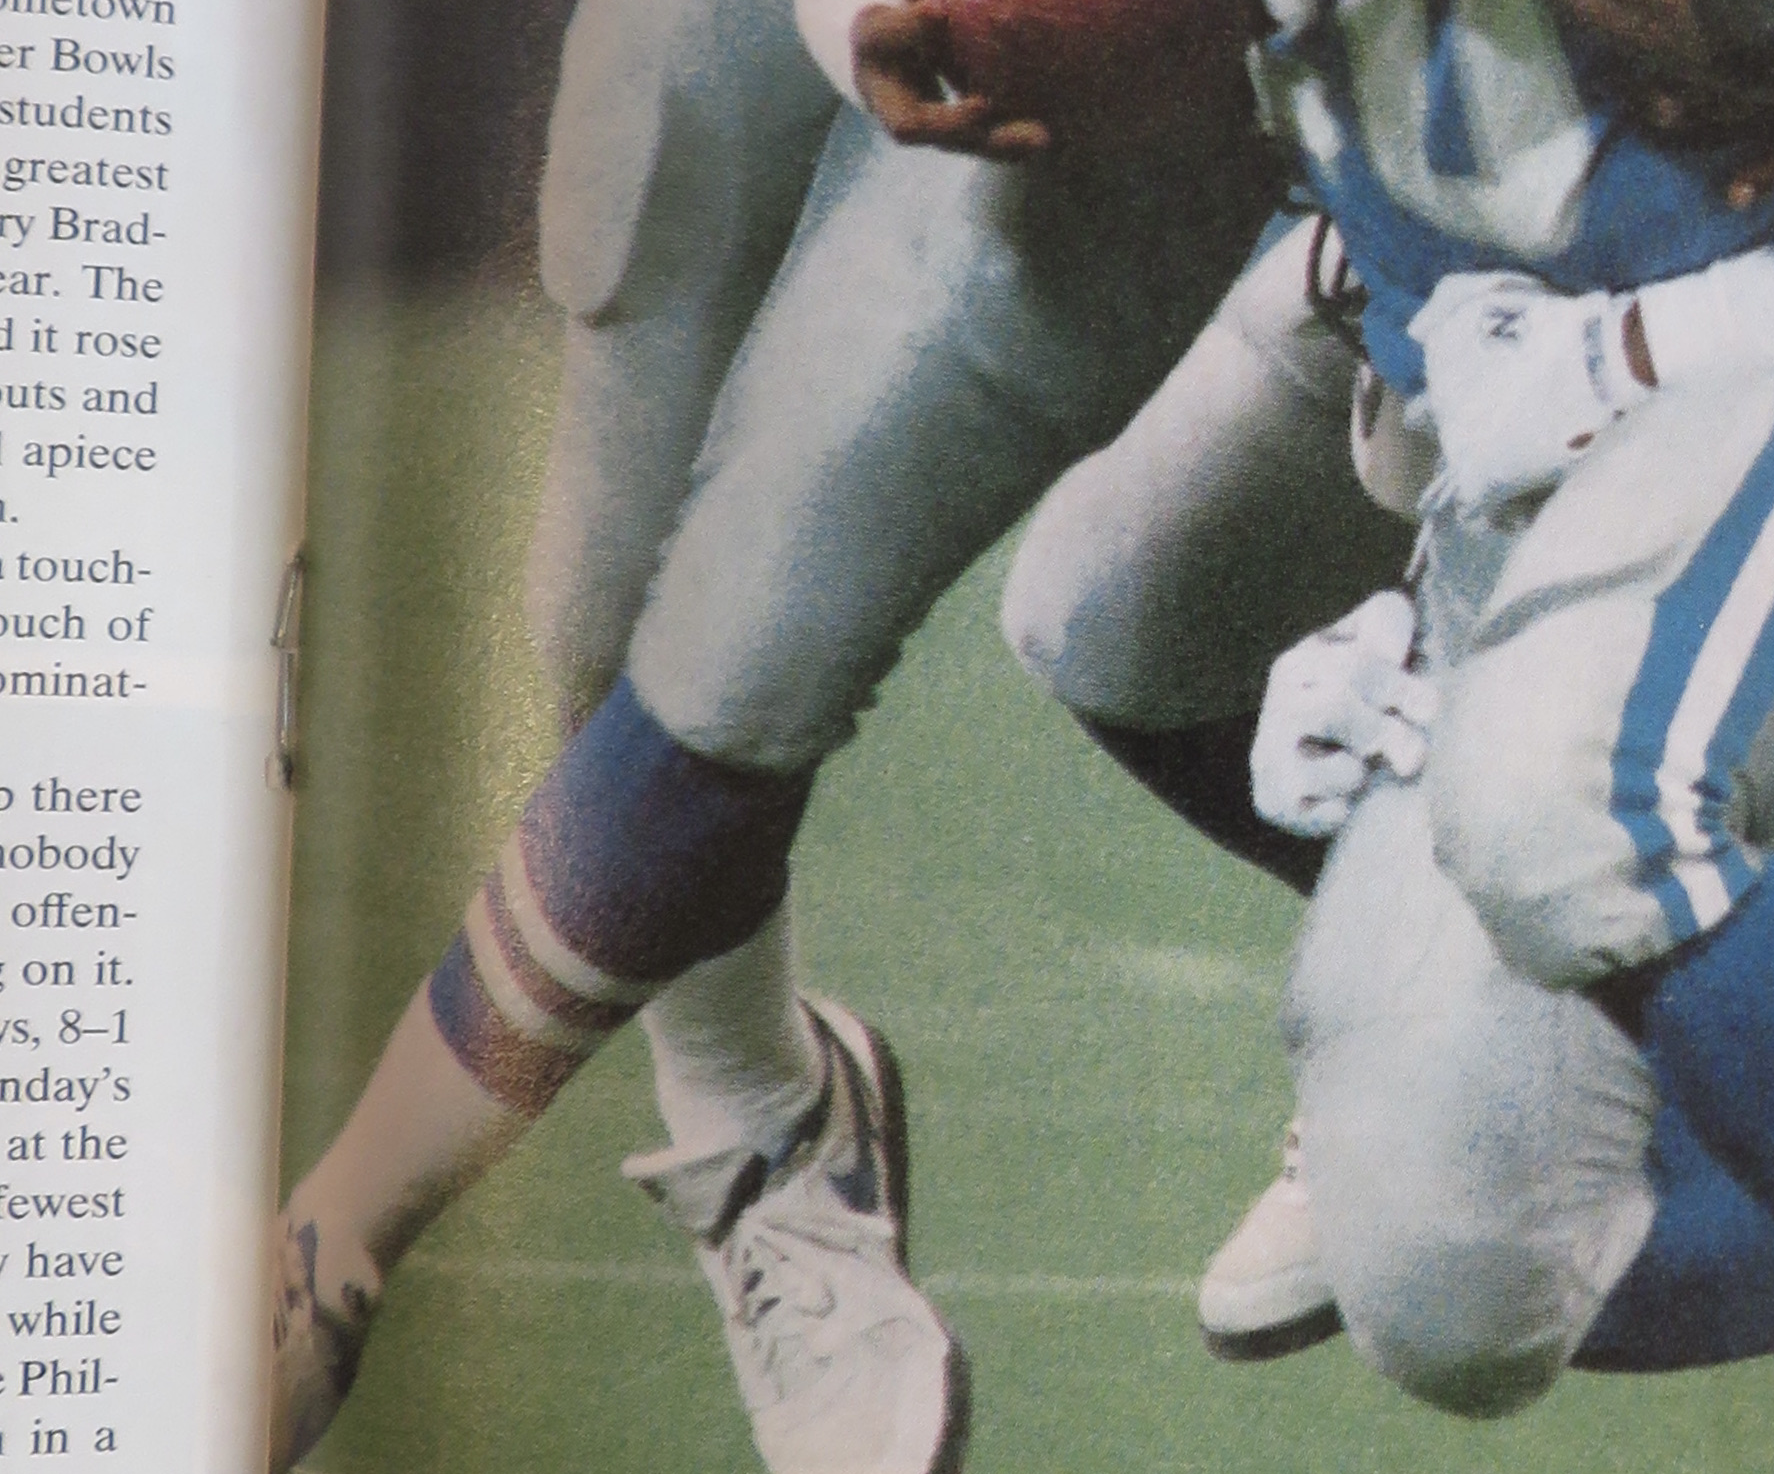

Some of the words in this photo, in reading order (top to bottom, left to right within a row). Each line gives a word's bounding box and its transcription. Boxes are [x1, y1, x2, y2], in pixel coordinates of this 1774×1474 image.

[50, 38, 175, 80] Bowls
[2, 157, 169, 192] greatest
[48, 206, 167, 245] Brad-
[31, 318, 58, 353] it
[75, 331, 162, 359] rose
[82, 381, 158, 414] and
[23, 434, 156, 478] apiece
[16, 549, 151, 584] touch-
[32, 777, 142, 813] there
[11, 892, 137, 928] offen-
[22, 961, 75, 986] on
[94, 950, 133, 985] it.
[7, 1131, 46, 1161] at
[60, 1124, 128, 1160] the
[25, 1241, 124, 1278] have
[7, 1299, 121, 1337] while
[17, 1358, 118, 1396] Phil-
[30, 1418, 69, 1455] in
[94, 1427, 117, 1452] a
